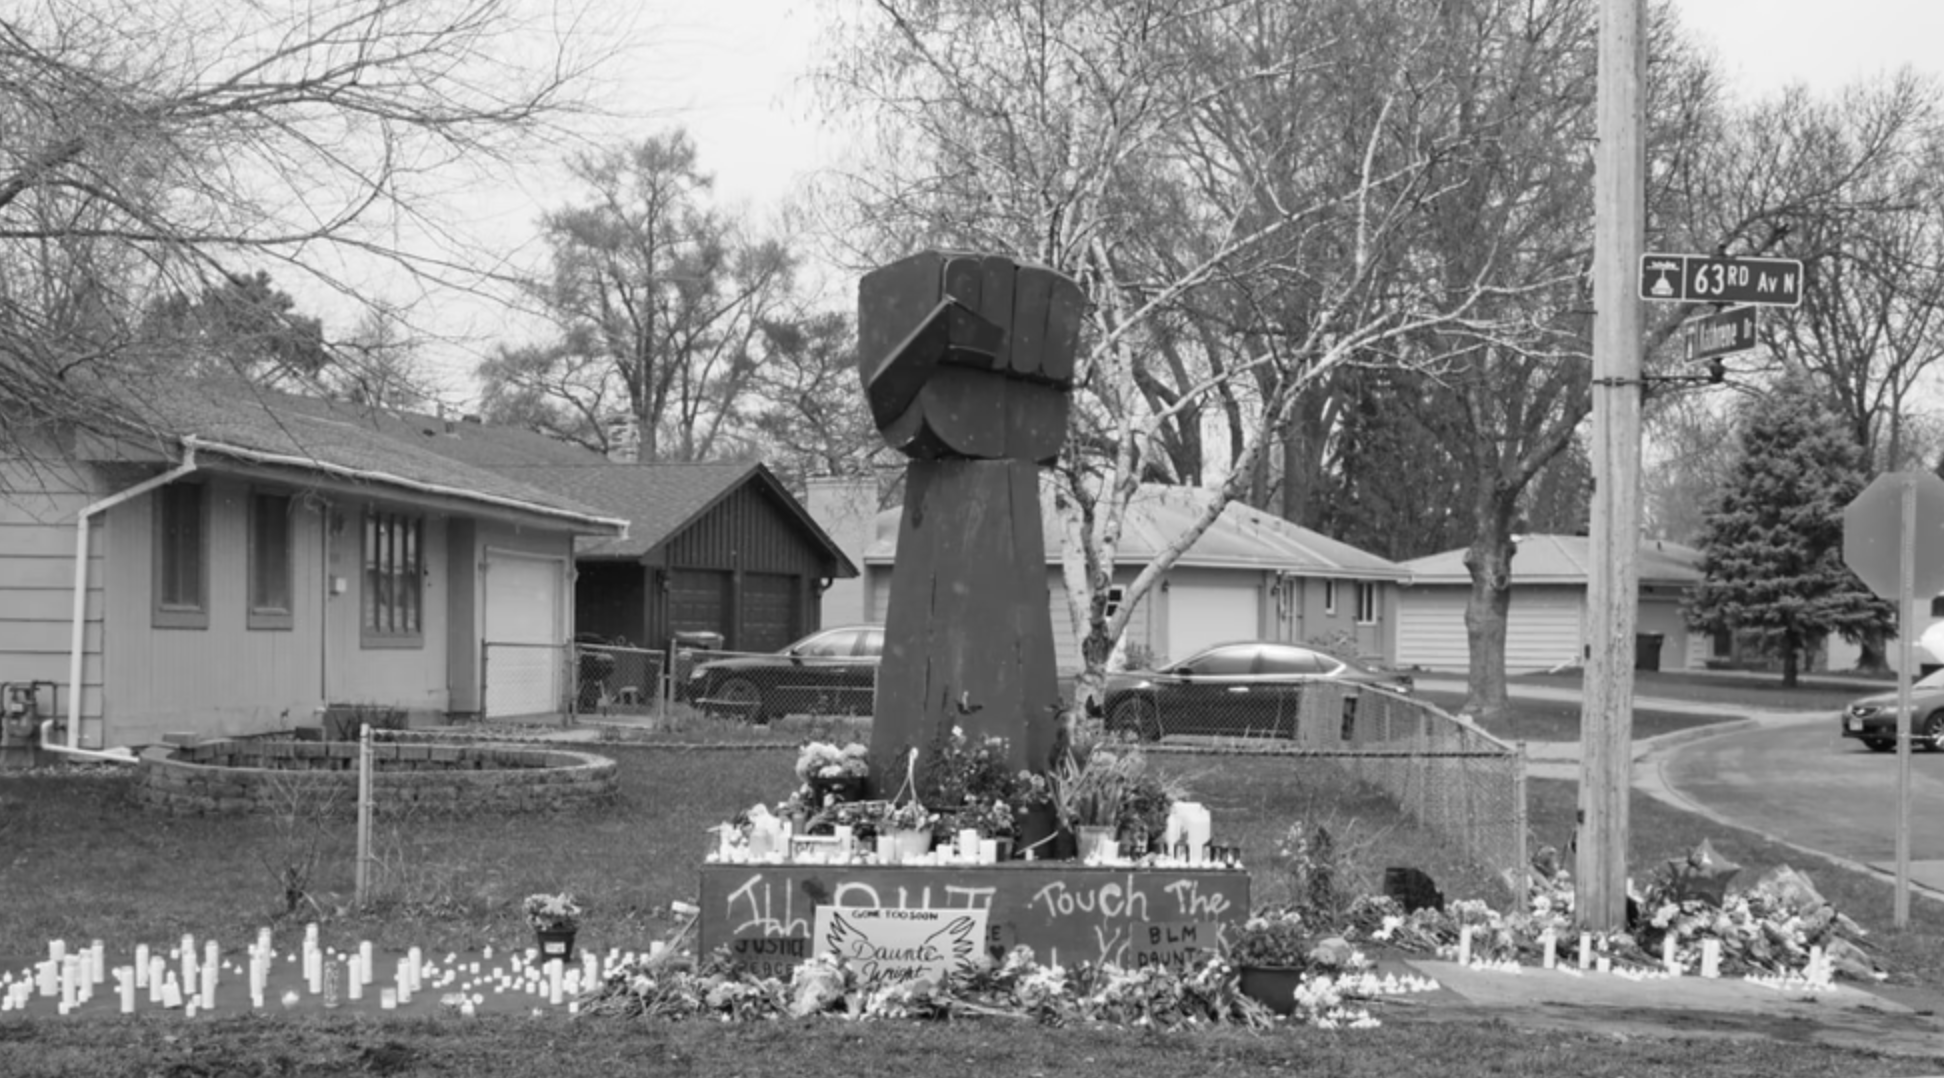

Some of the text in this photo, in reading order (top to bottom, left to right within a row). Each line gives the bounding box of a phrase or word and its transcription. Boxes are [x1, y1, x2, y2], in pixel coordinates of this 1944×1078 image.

[1694, 264, 1749, 294] 63RD
[1757, 272, 1779, 292] Av
[1783, 272, 1795, 294] N
[1150, 926, 1197, 944] BLM
[851, 940, 944, 961] Daunte
